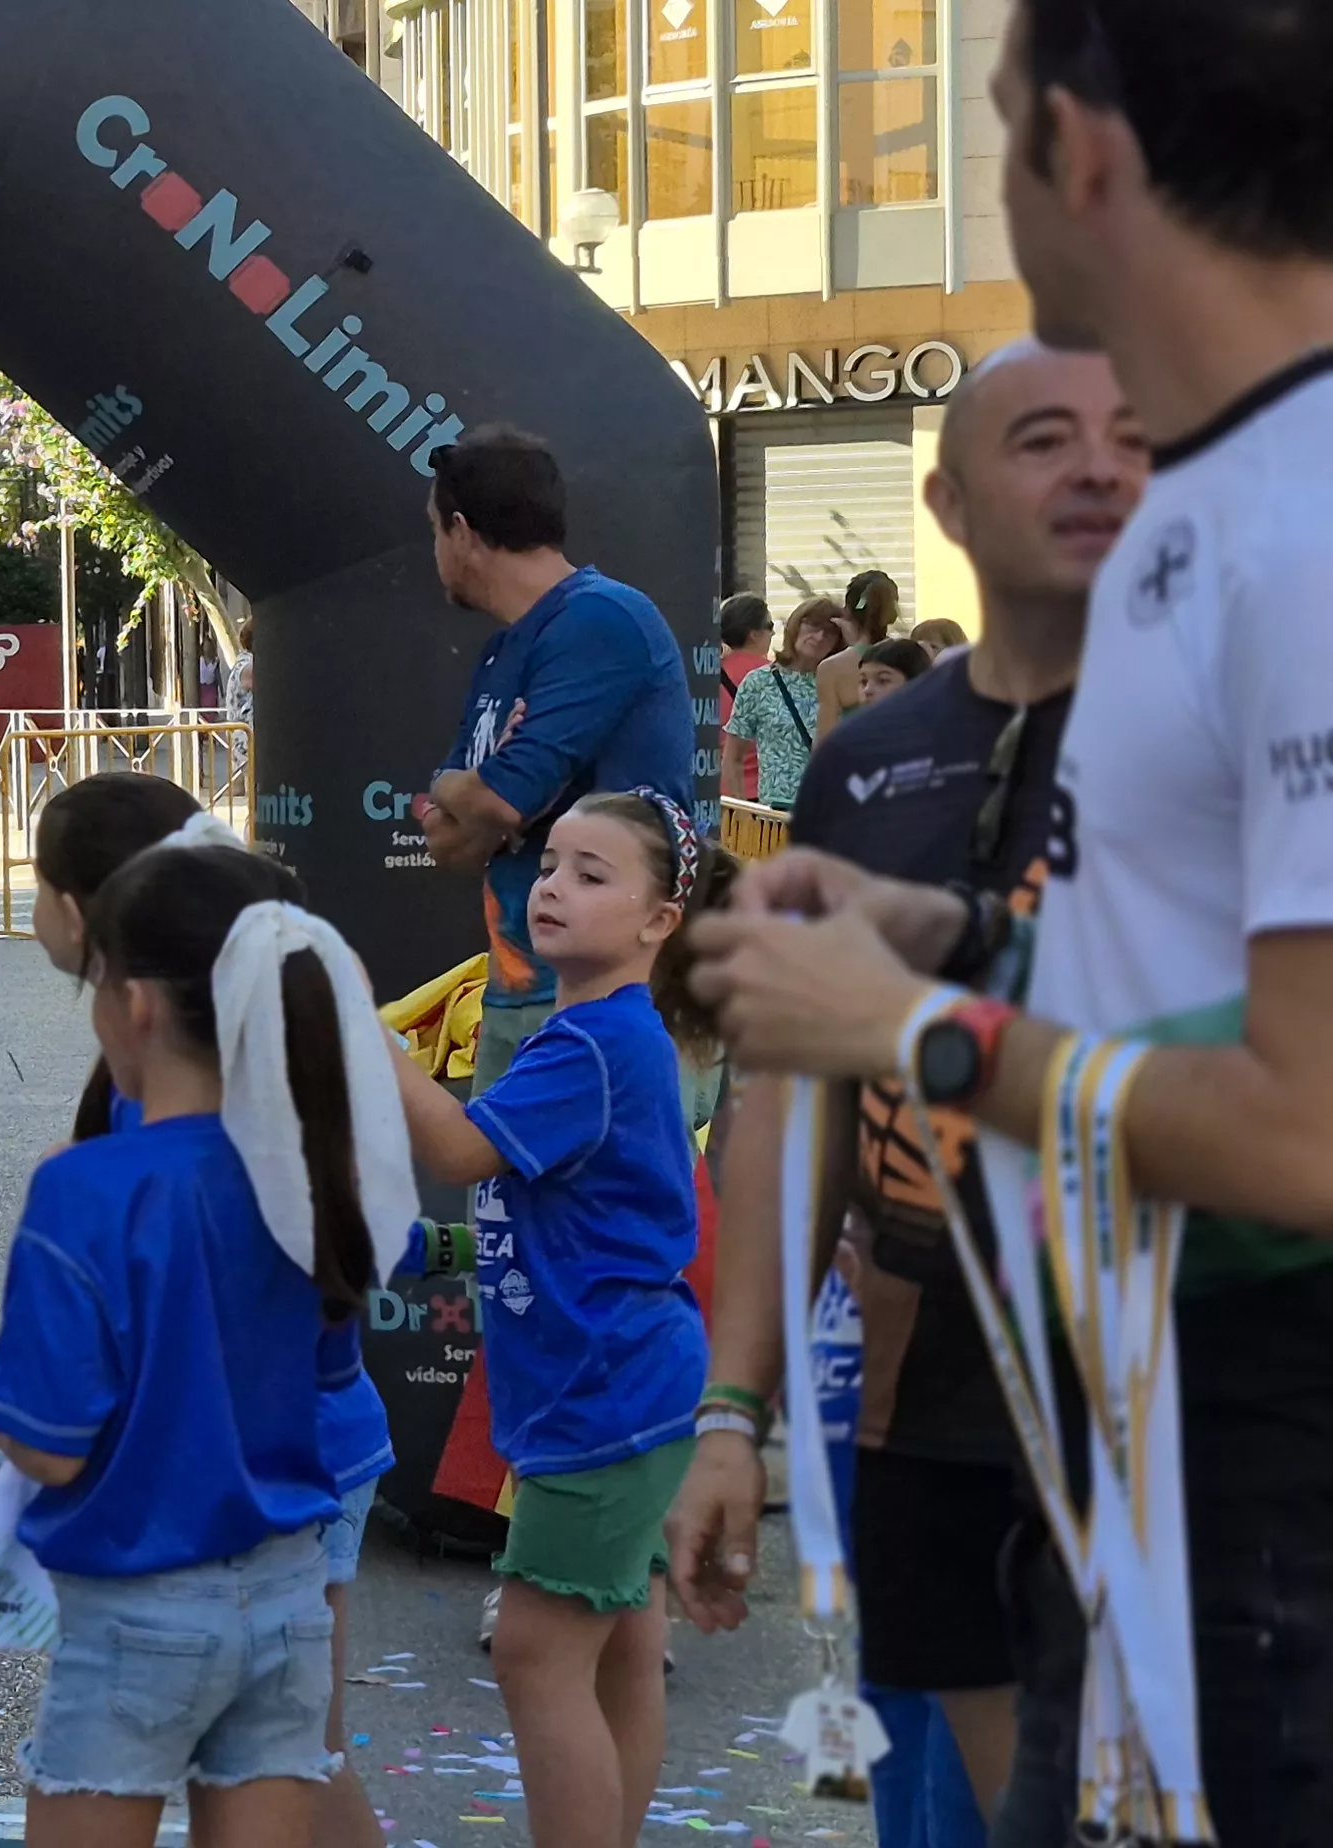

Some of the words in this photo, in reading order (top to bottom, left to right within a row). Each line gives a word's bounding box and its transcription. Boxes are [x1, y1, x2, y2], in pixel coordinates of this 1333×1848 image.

[672, 340, 963, 413] MANGO
[392, 831, 429, 847] Serv
[475, 1232, 514, 1259] SCA
[444, 1344, 476, 1361] Ser
